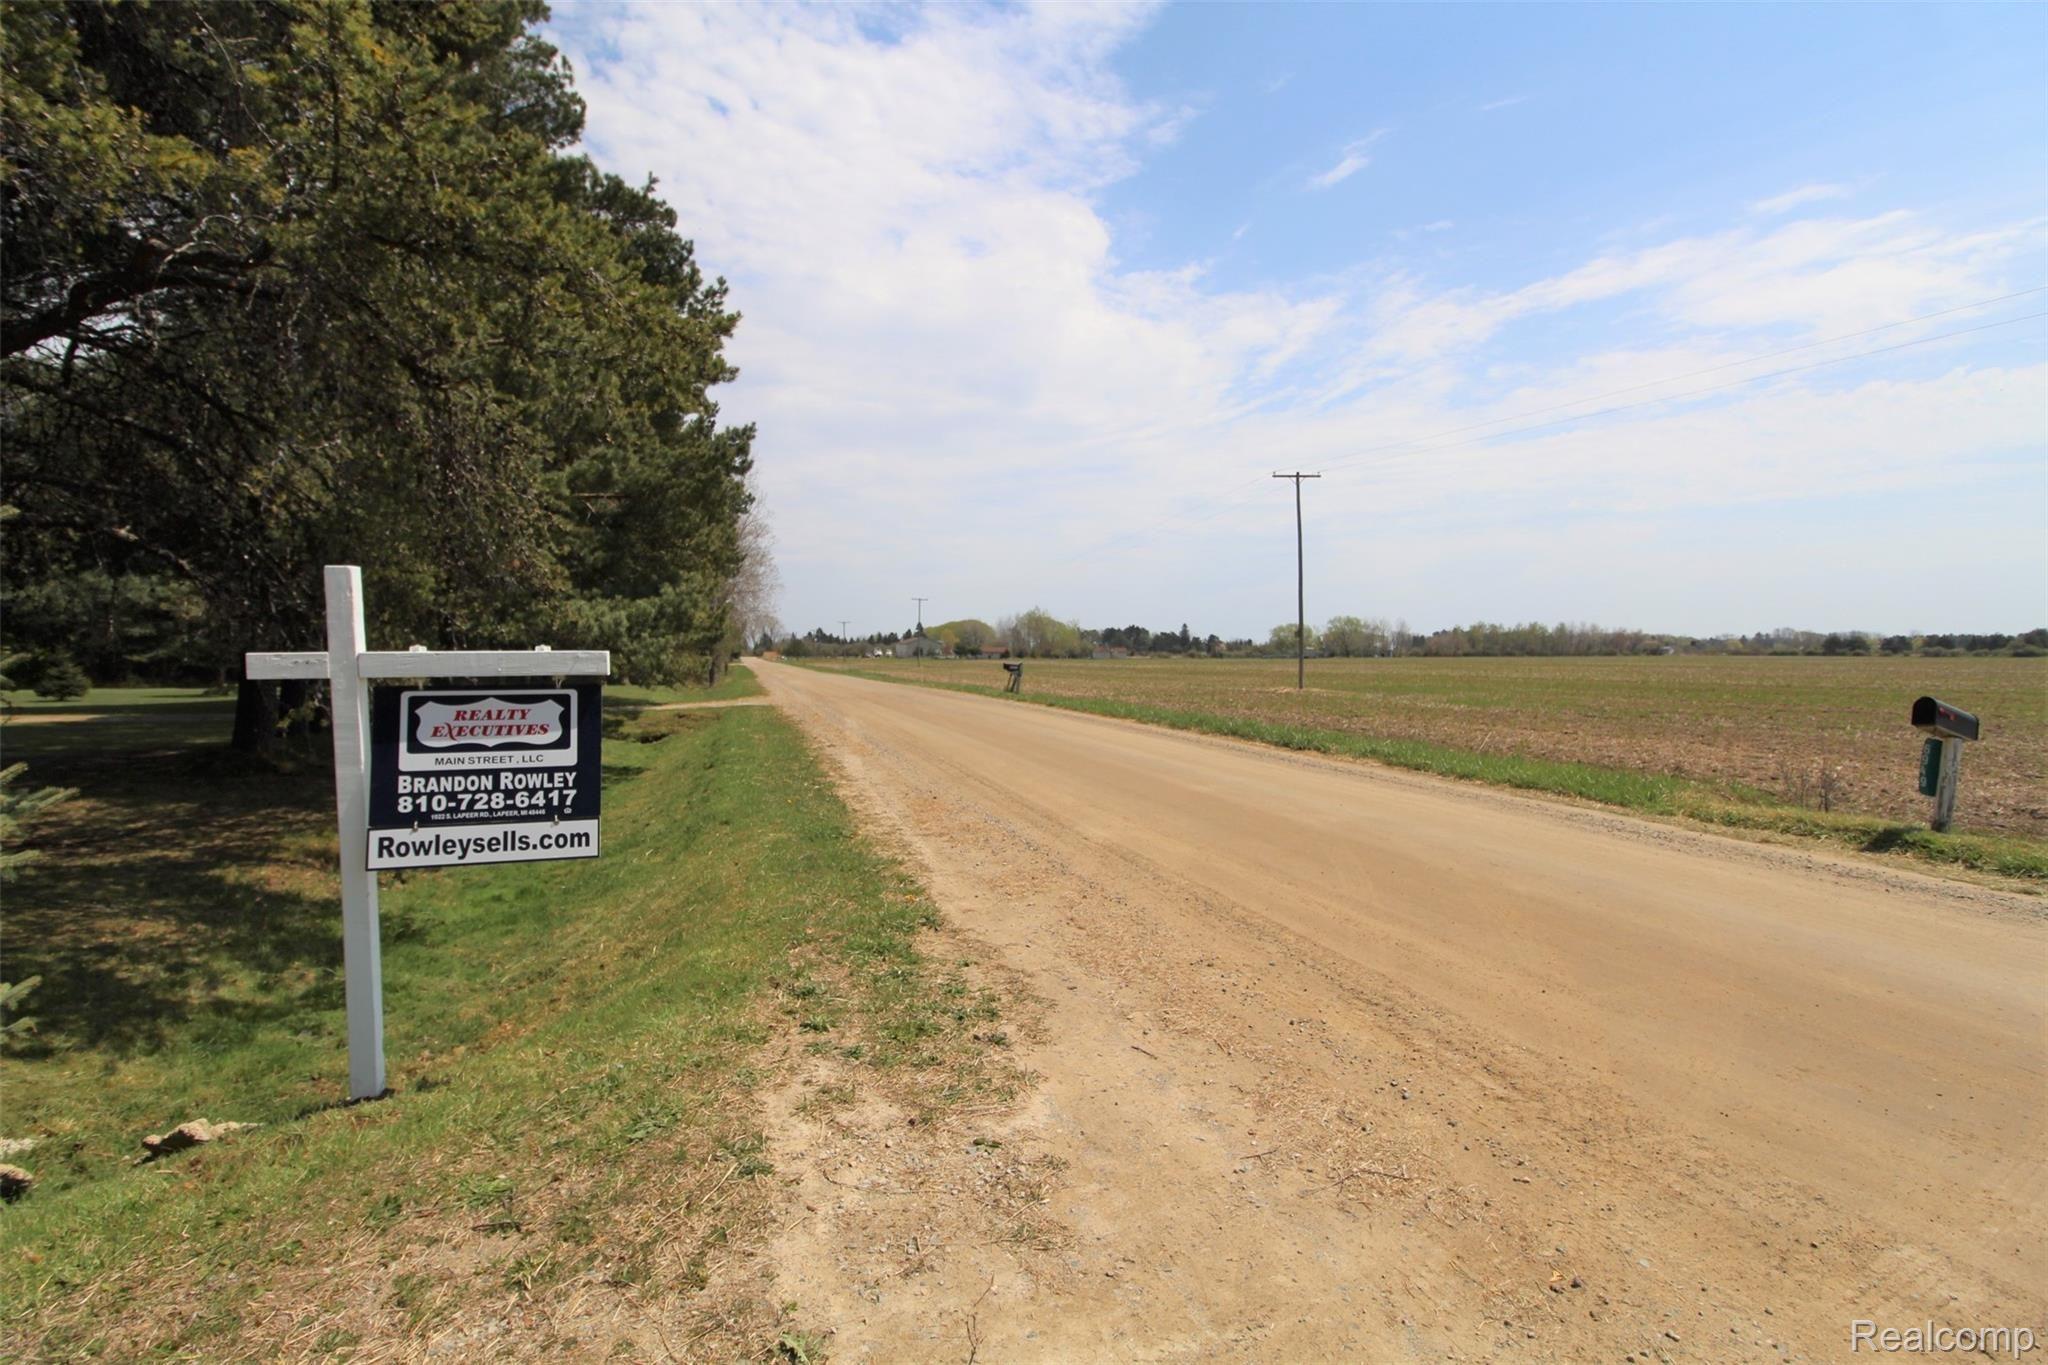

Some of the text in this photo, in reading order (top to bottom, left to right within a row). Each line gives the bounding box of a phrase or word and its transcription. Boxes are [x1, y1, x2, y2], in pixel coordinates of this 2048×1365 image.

[453, 709, 531, 722] REALTY
[430, 723, 550, 741] EXECUTIVES
[435, 756, 467, 766] MAIN
[522, 754, 544, 763] LLC
[398, 771, 577, 794] BRANDON ROWLEY
[397, 789, 577, 813] 810-728-6417
[453, 811, 479, 819] LAPEER
[377, 830, 590, 860] Rowleysells.com
